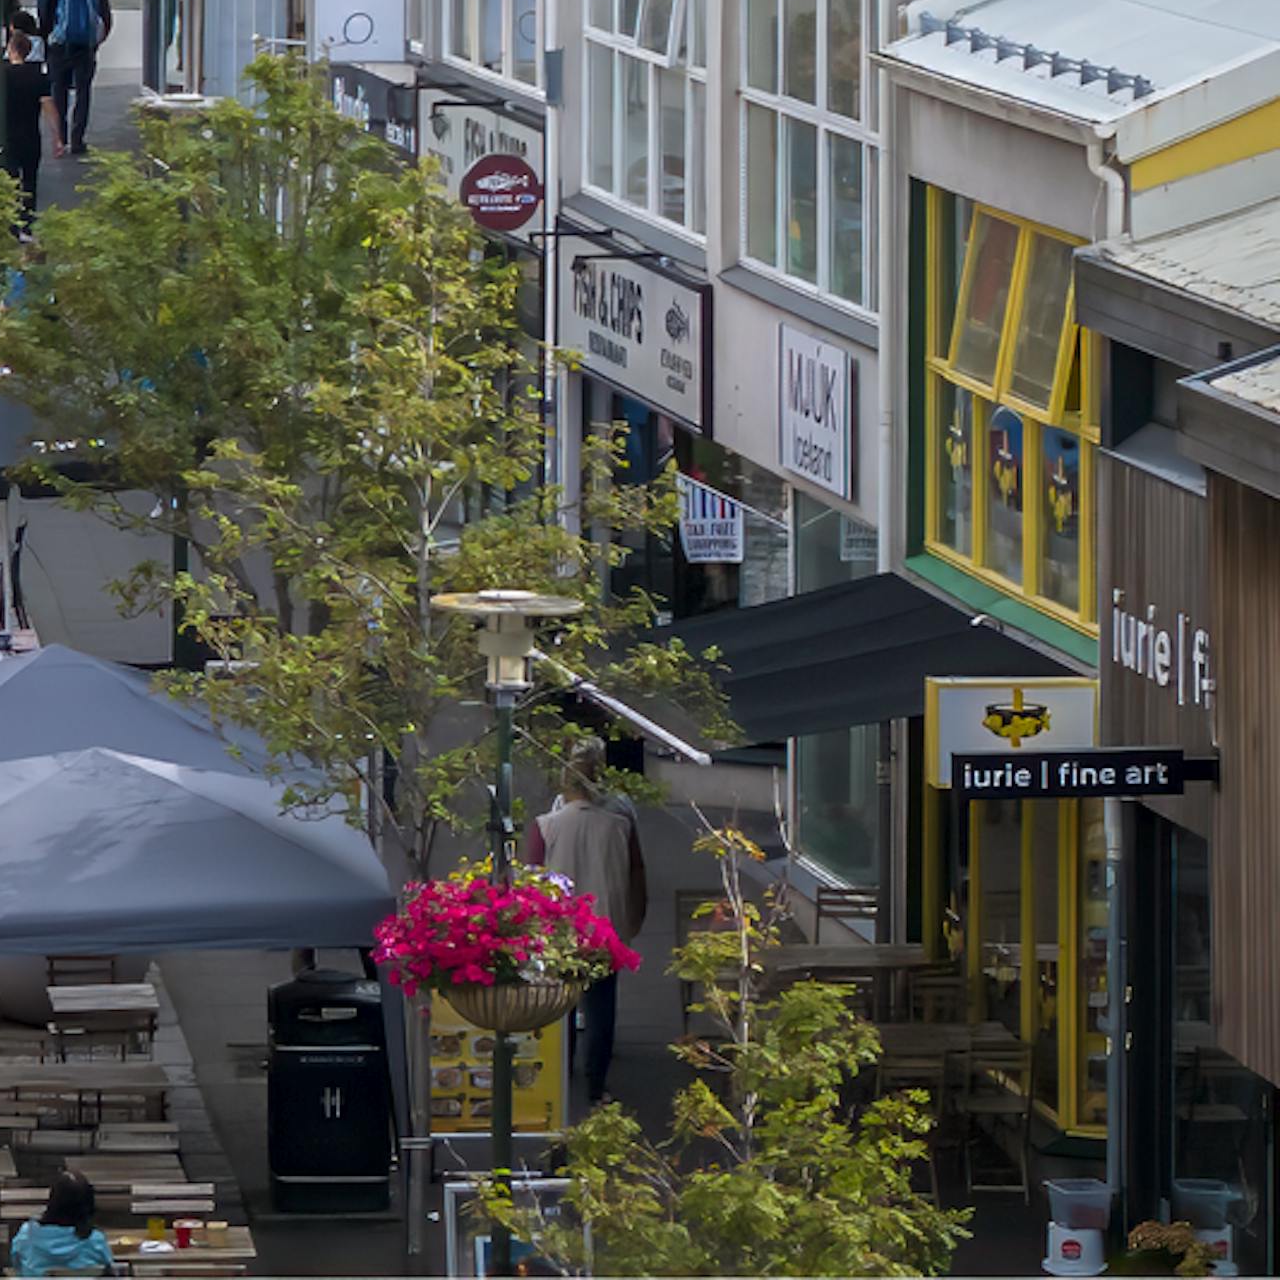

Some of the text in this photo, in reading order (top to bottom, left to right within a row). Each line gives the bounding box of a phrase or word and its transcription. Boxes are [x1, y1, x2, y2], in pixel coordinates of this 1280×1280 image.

[1112, 588, 1171, 687] iurie
[963, 762, 1032, 789] iurie
[1058, 761, 1116, 787] fine
[1125, 761, 1169, 786] art
